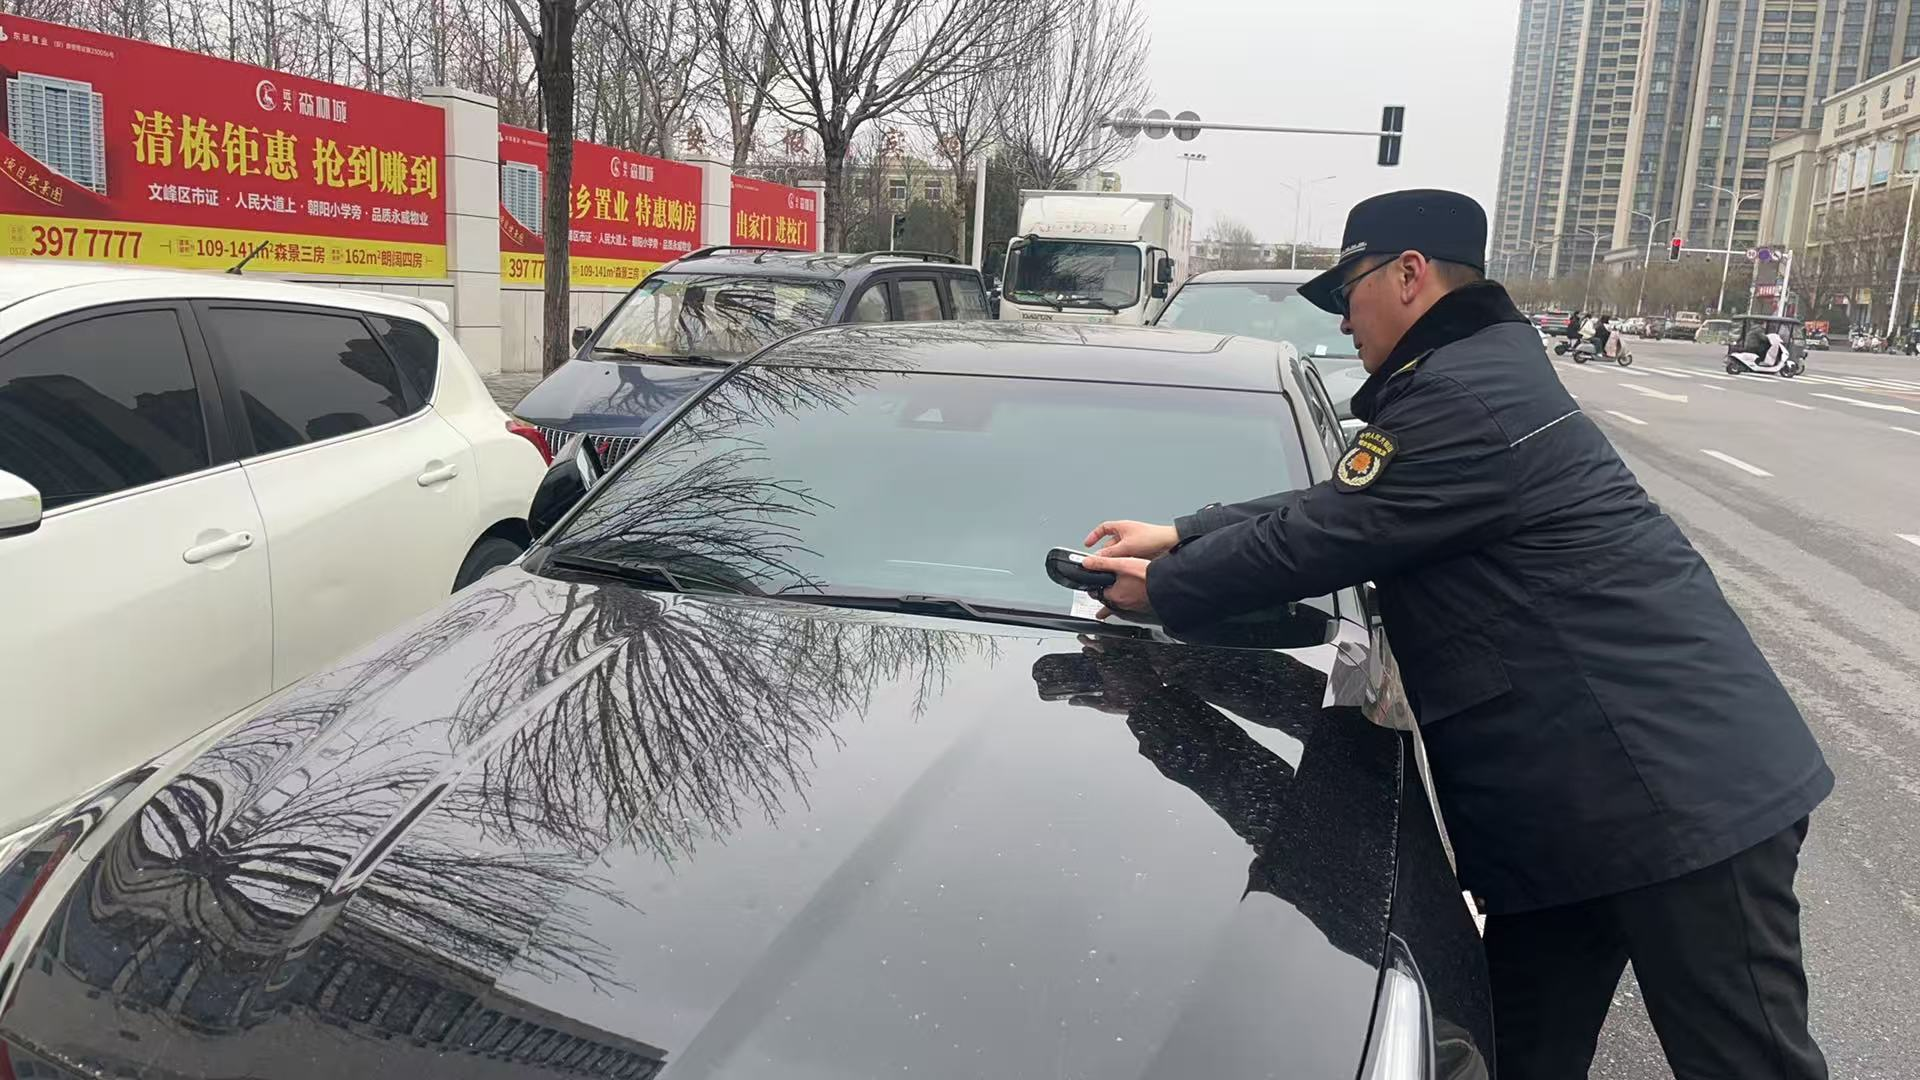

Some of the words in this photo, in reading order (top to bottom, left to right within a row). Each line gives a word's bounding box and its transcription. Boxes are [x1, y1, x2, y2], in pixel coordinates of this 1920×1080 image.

[299, 92, 347, 123] 森林城
[131, 110, 299, 180] 清栋钜惠
[312, 137, 437, 199] 抢到赚到
[148, 183, 219, 206] 文峰区市证
[235, 192, 297, 214] 人民大道上
[307, 200, 361, 220] 朝阳小学旁
[568, 184, 629, 222] 乡置业
[635, 193, 697, 232] 特惠购房
[31, 225, 78, 256] 397
[84, 228, 143, 259] 7777
[736, 210, 771, 242] 出家门
[775, 215, 807, 246] 进校门
